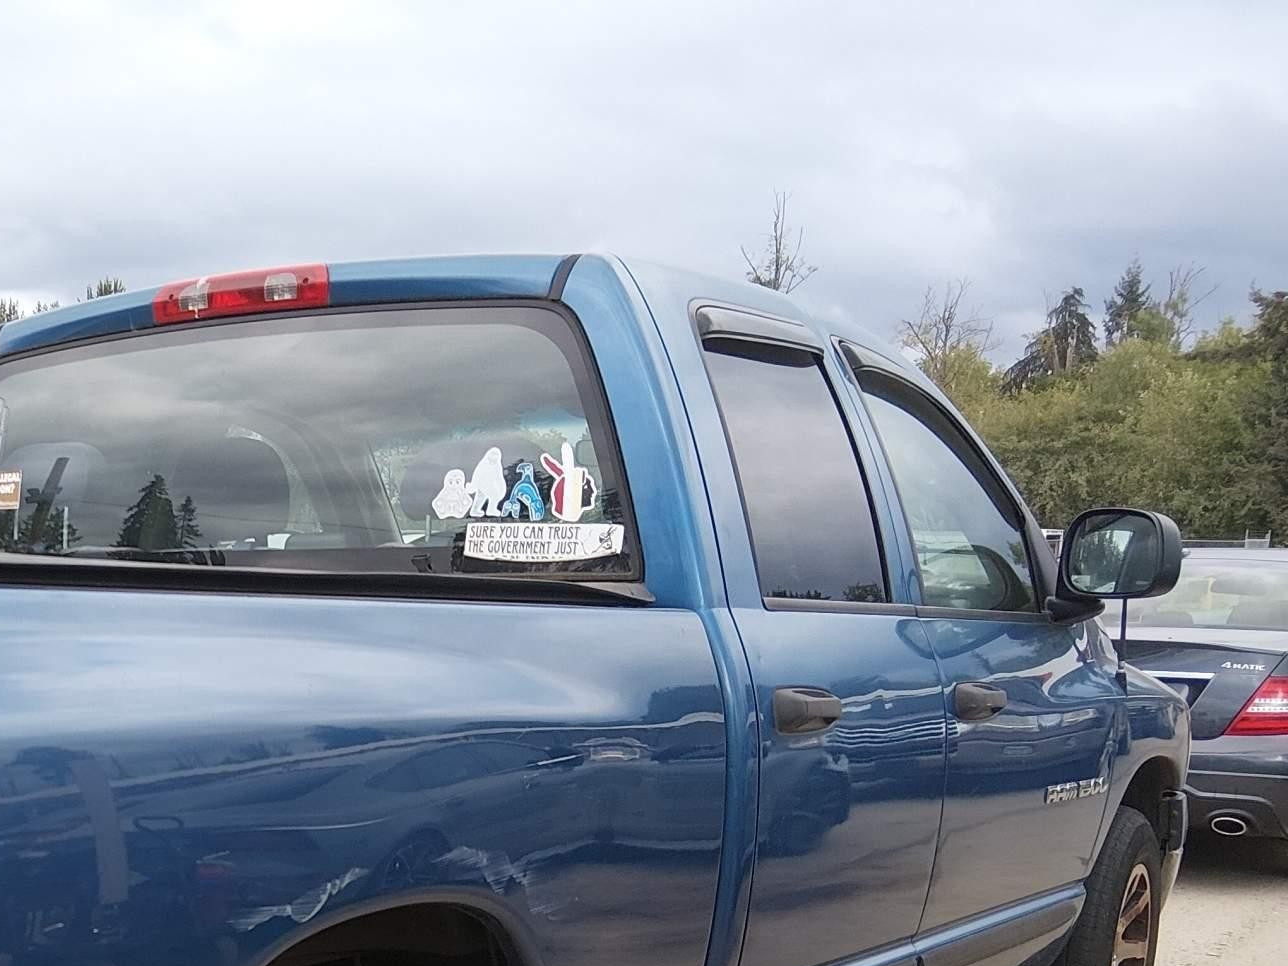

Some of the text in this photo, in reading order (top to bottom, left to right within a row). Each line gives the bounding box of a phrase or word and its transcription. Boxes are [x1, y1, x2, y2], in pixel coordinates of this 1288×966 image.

[469, 525, 581, 540] SURE YOU CAN TRUST
[468, 540, 579, 555] THE GOVERNMENT JUST
[1221, 661, 1266, 671] 4MATIC
